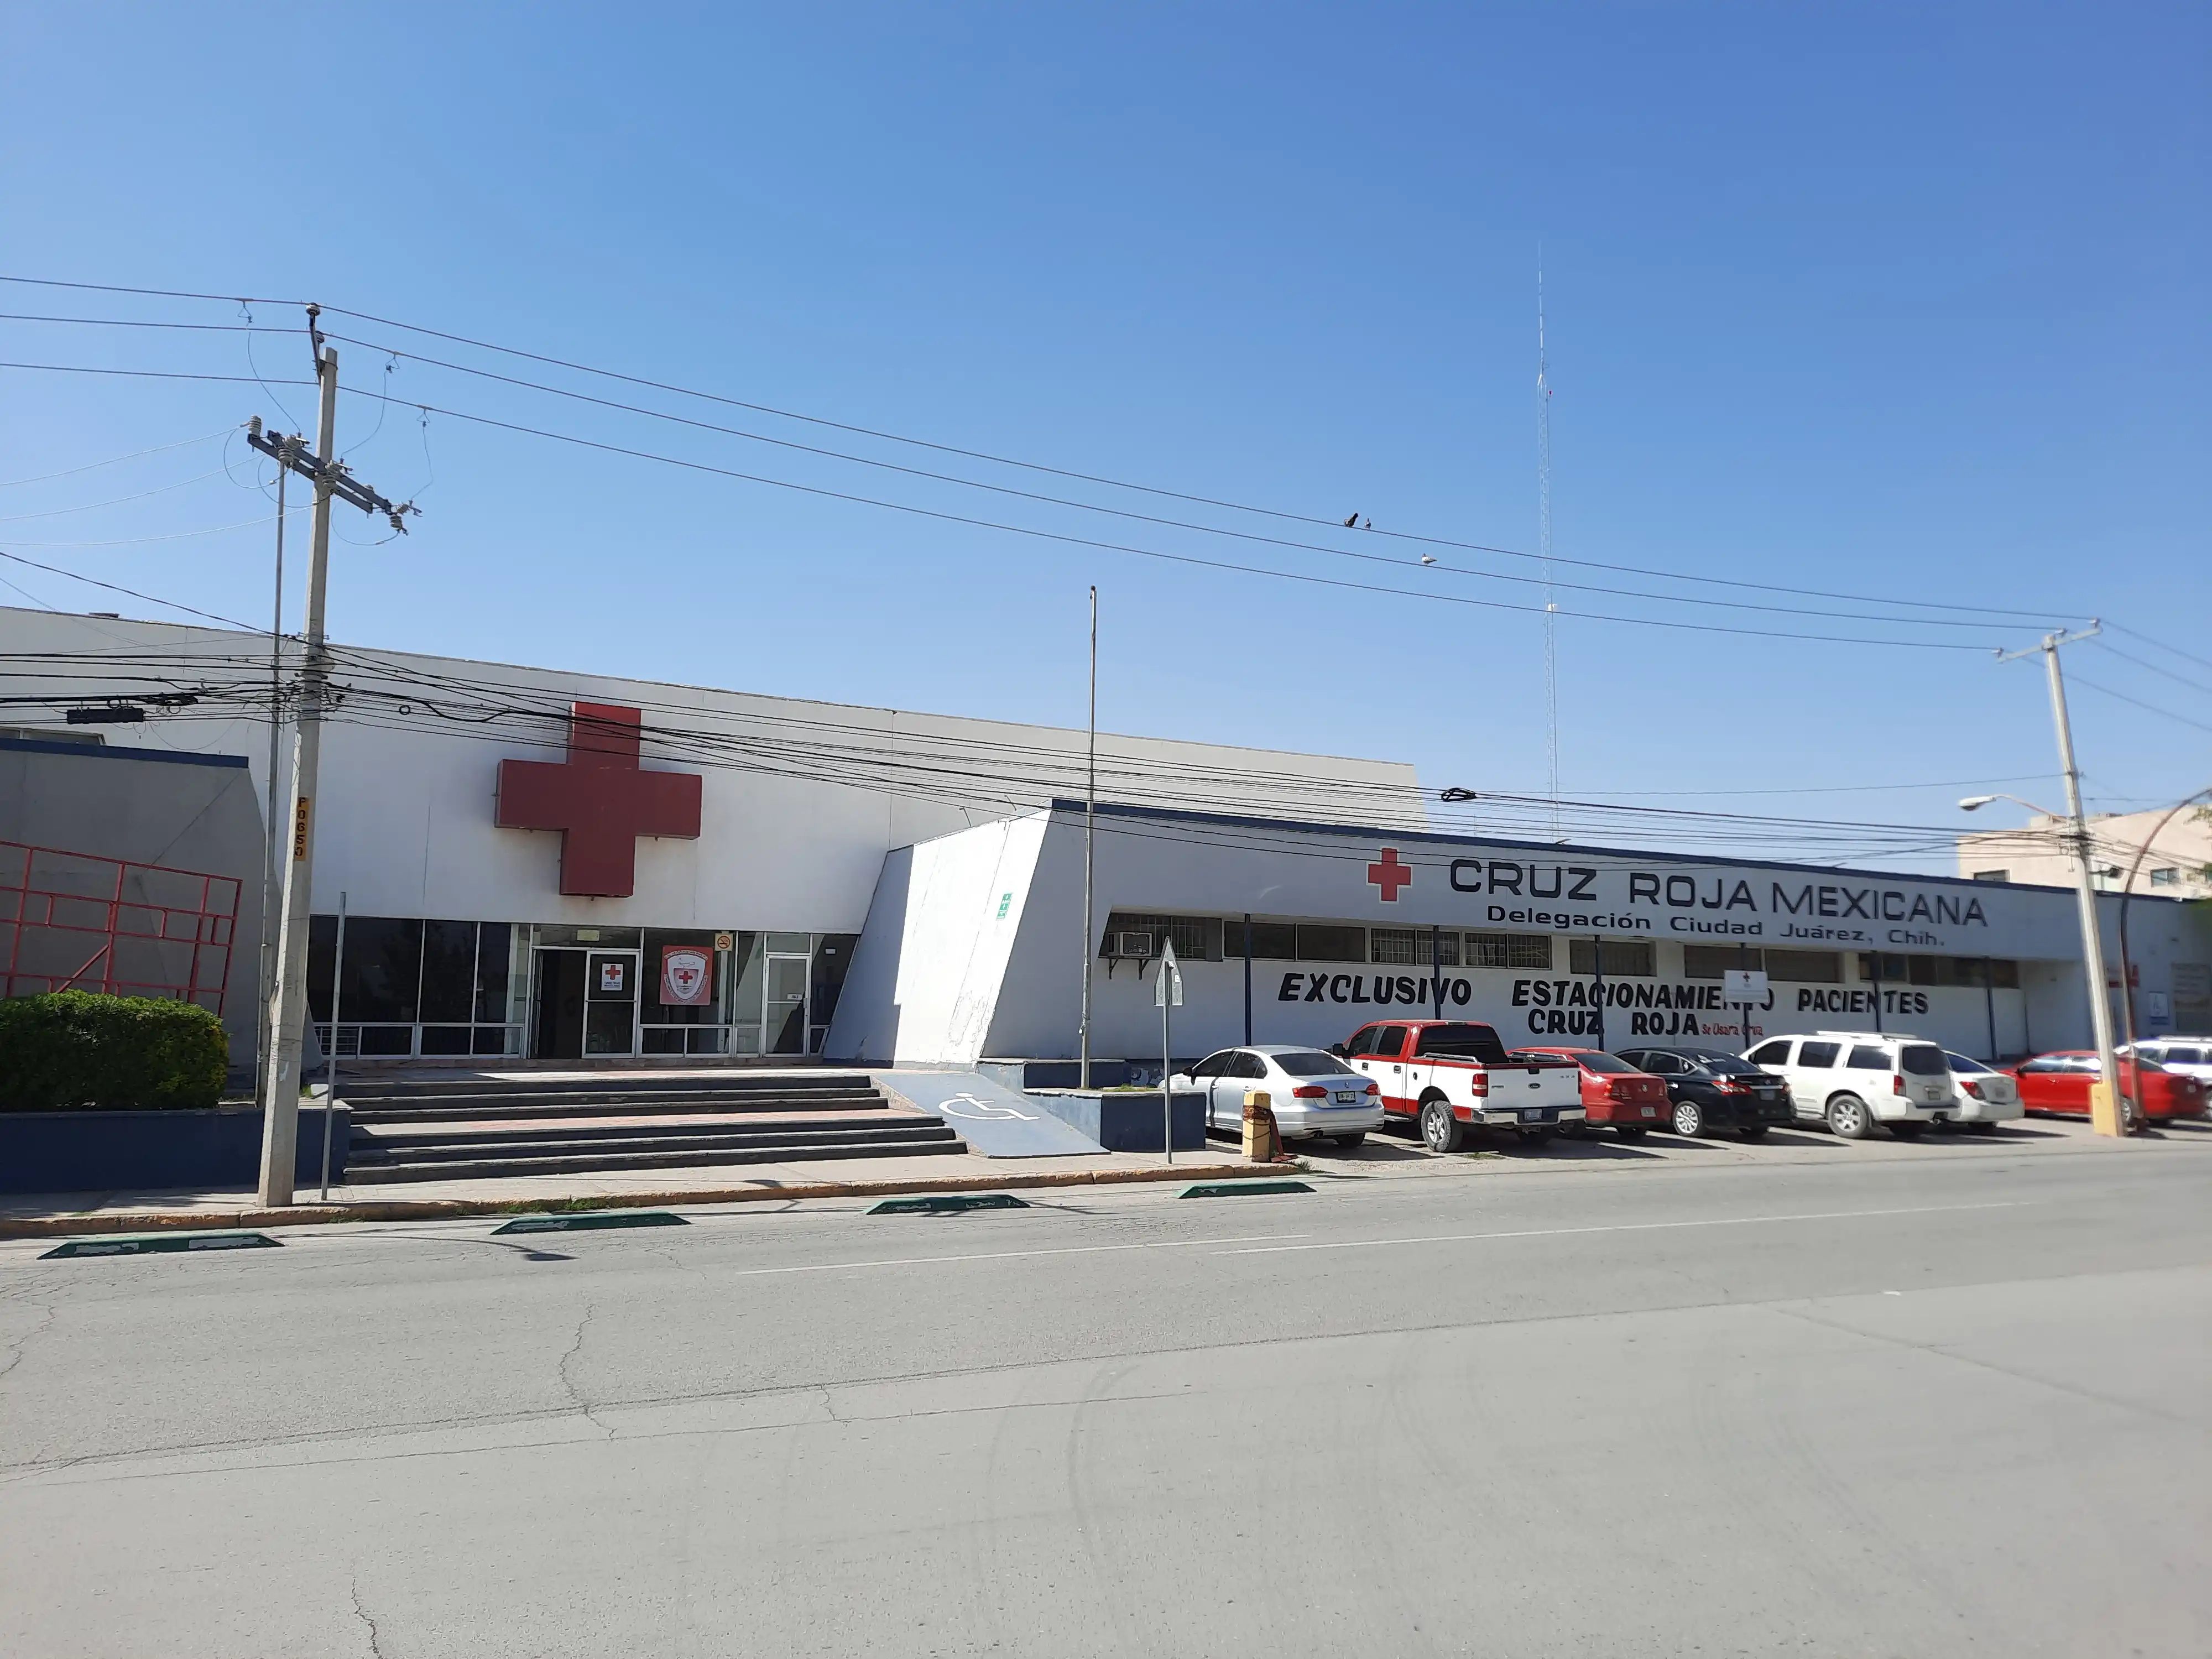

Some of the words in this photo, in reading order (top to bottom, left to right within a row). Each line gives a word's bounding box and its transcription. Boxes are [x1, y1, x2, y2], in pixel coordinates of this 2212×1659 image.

[1451, 859, 1597, 901] CRUZ
[1630, 873, 1757, 911] ROJA
[1771, 882, 1988, 927] MEXICANA
[1488, 905, 1651, 929] Delegación
[1670, 916, 1762, 935] Ciudad
[1780, 922, 1874, 944] Juárez,
[1888, 929, 1945, 946] Chih.
[1278, 973, 1472, 1005] EXCLUSIVO
[1512, 980, 1775, 1011] ESTACIONAMIEO
[1798, 988, 1929, 1014] PACIENTES
[1528, 1009, 1605, 1035] CRUZ
[1631, 1012, 1699, 1036] ROJA
